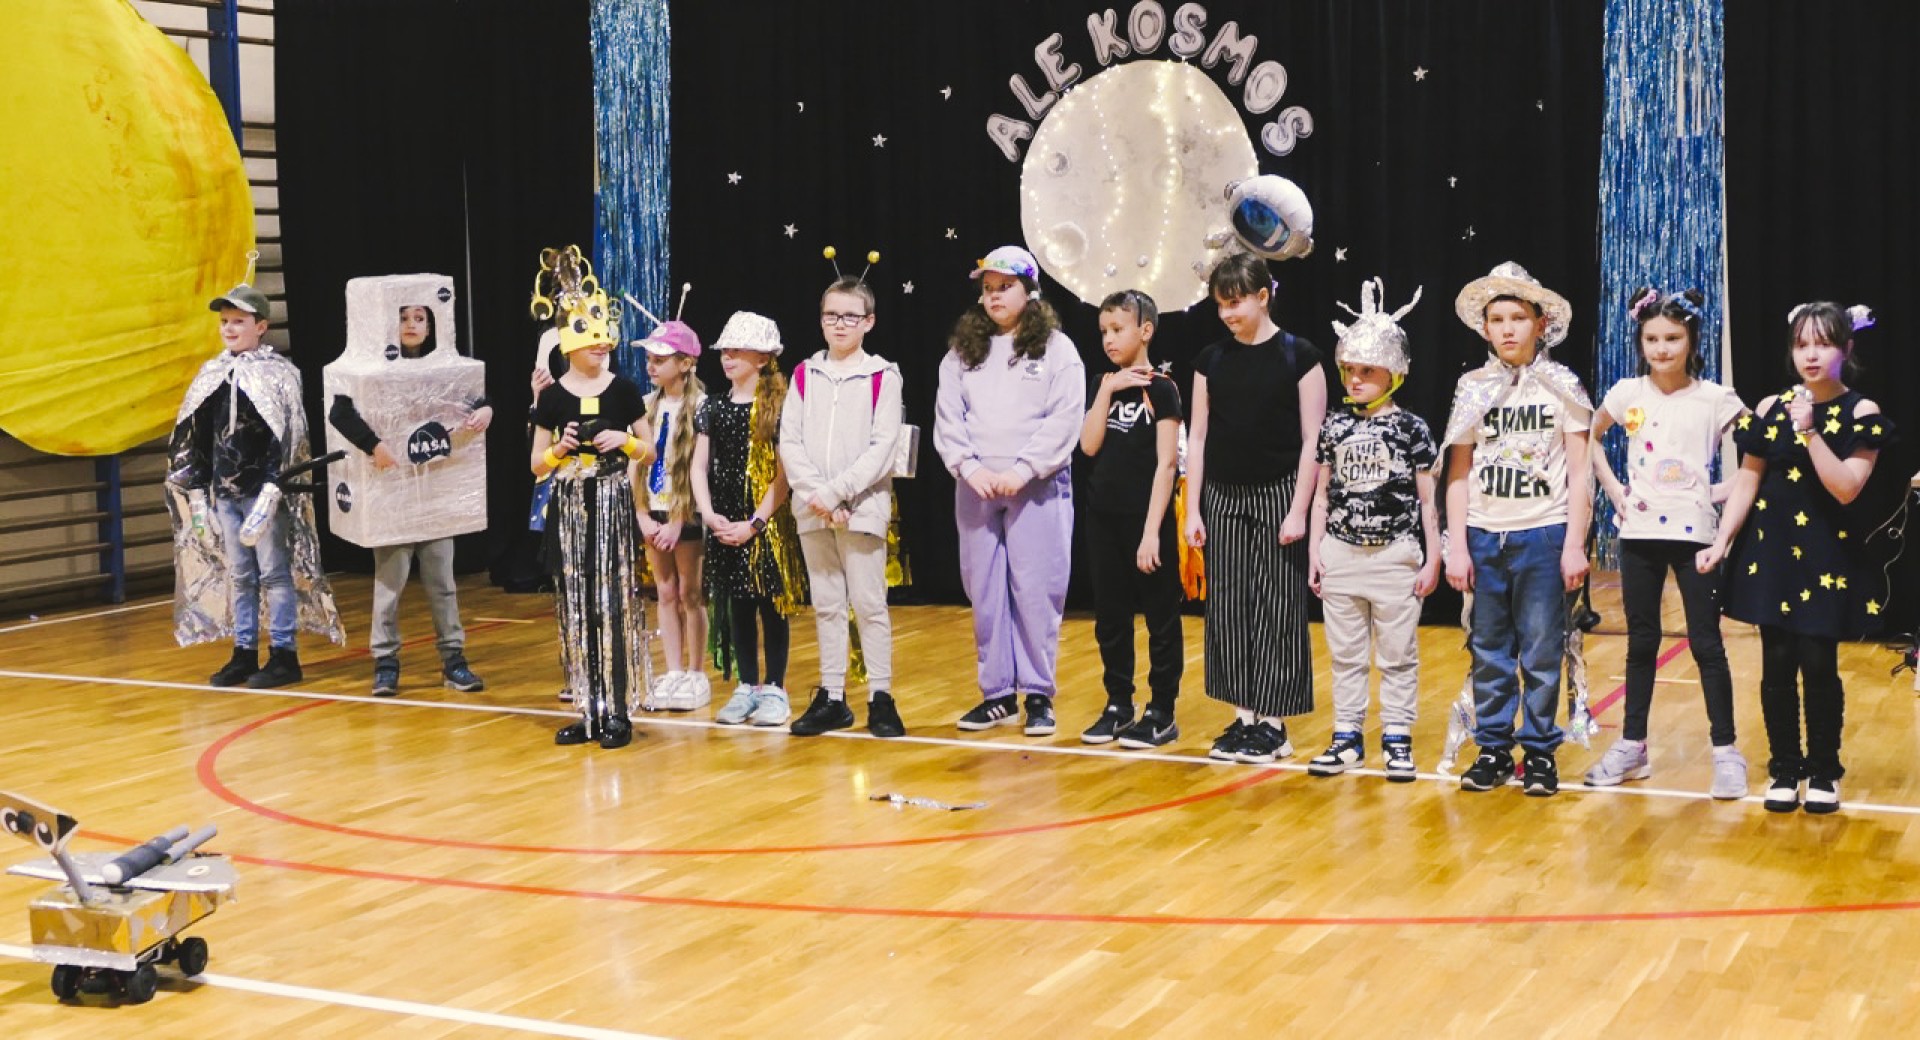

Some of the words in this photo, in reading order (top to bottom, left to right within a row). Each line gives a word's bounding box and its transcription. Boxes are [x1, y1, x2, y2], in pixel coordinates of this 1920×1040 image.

[986, 32, 1082, 163] ALE
[1086, 0, 1314, 157] KOSMOS
[1108, 400, 1151, 425] ASA
[410, 438, 449, 454] NASA
[1344, 440, 1383, 464] AWE
[1340, 460, 1386, 484] SOME
